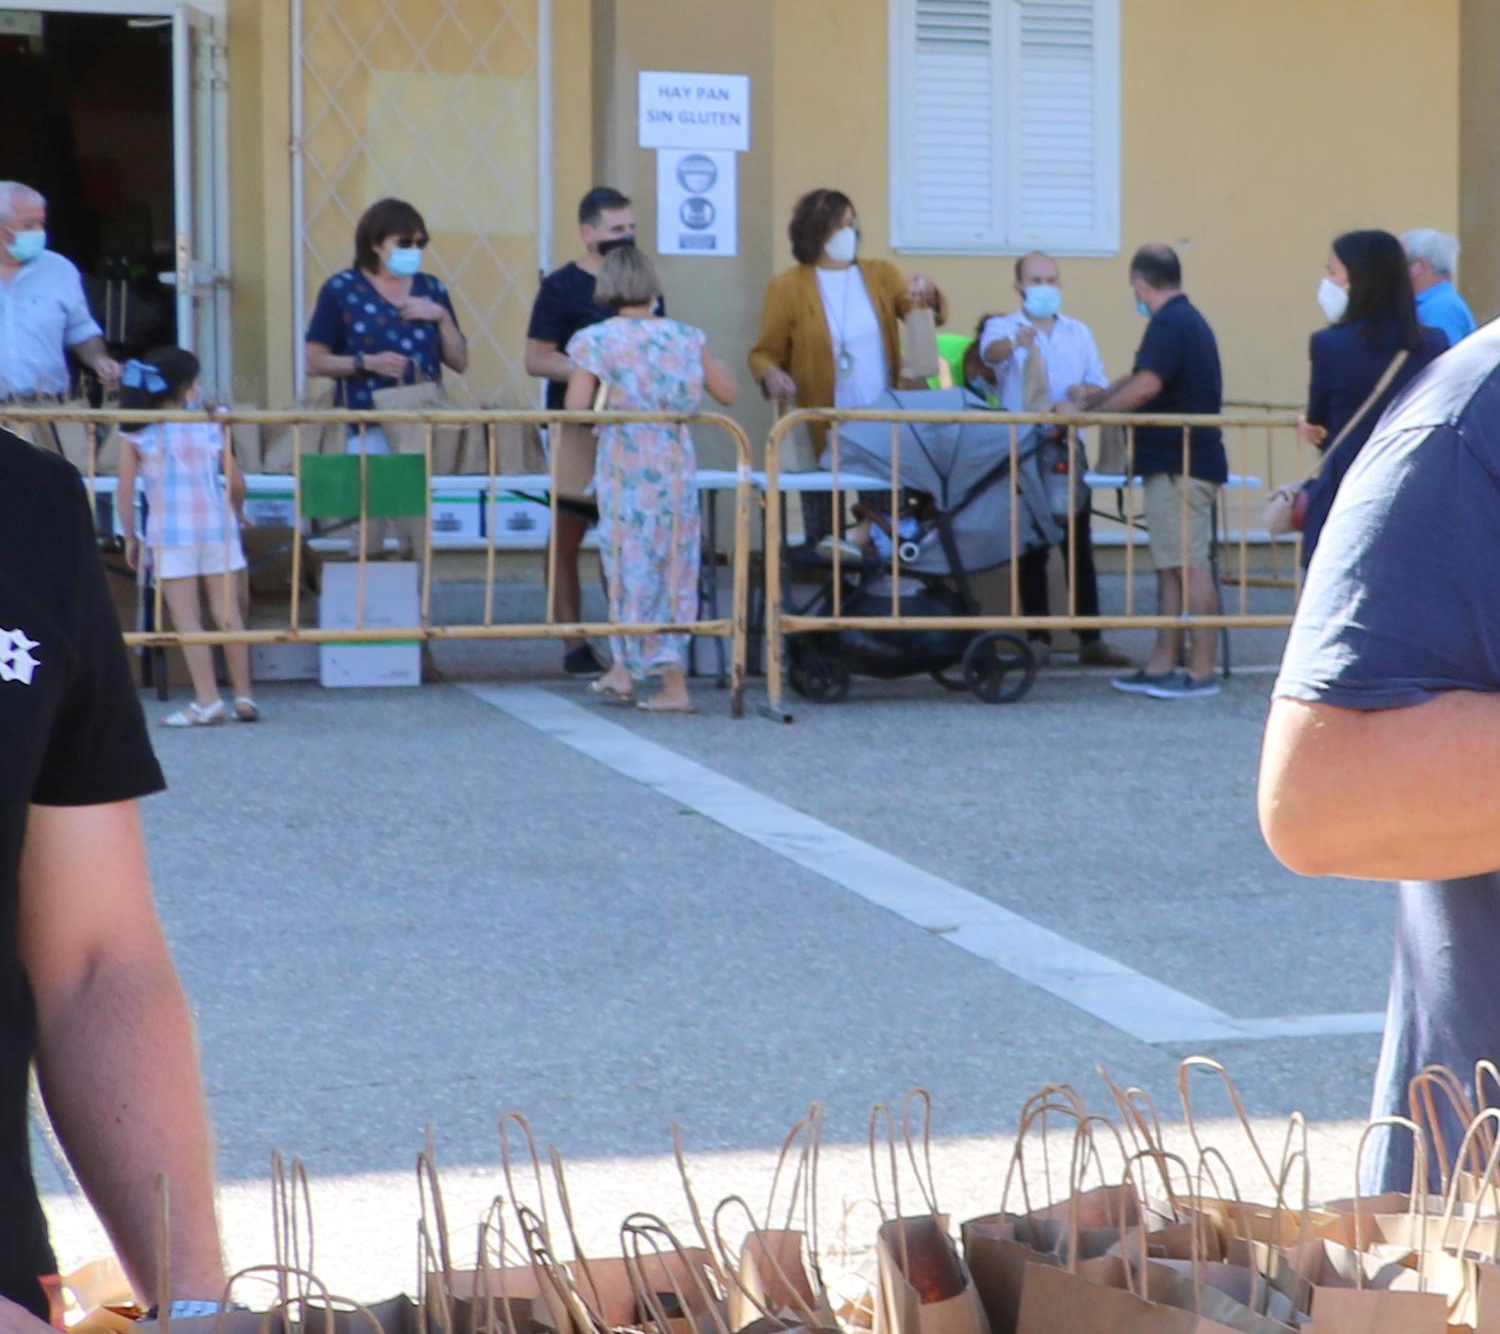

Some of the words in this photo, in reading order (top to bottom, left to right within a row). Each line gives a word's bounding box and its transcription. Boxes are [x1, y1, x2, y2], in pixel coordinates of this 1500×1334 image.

[658, 85, 692, 99] HAY
[697, 87, 730, 101] PAN
[646, 109, 674, 124] SIN
[678, 110, 741, 126] GLUTEN
